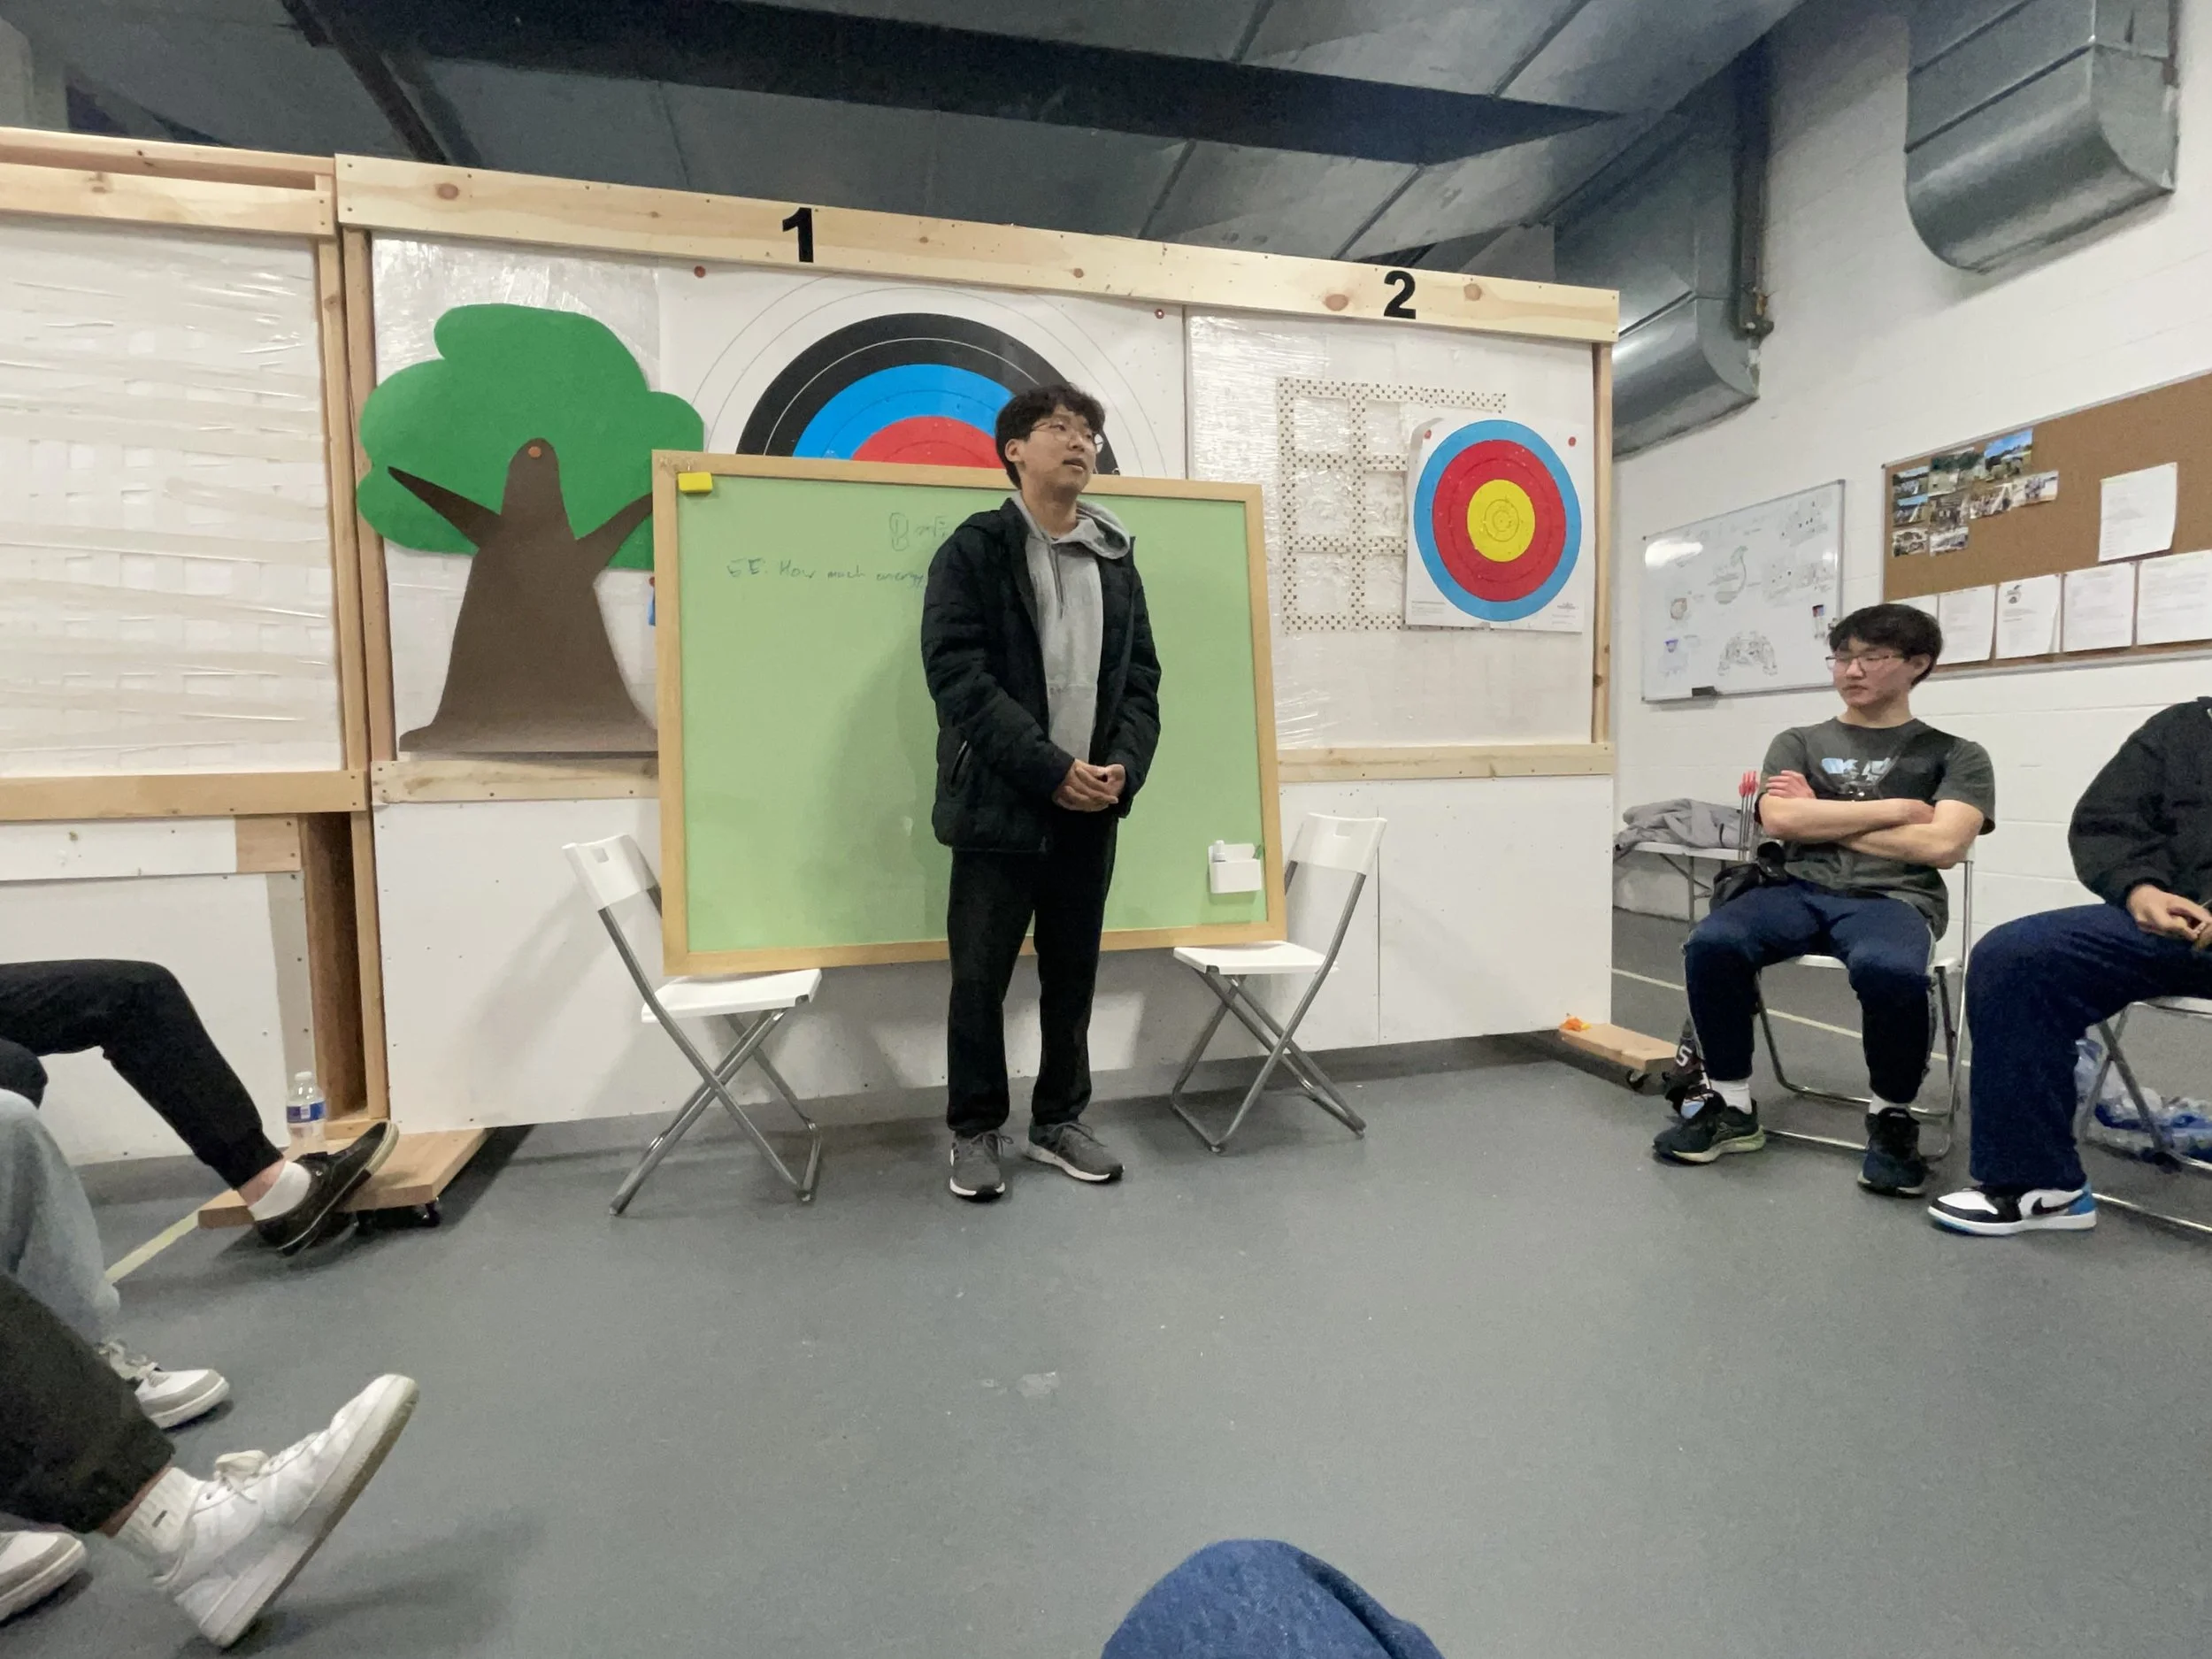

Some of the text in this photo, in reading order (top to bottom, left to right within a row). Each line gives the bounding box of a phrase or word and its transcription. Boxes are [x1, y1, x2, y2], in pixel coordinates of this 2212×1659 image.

[782, 206, 814, 264] 1
[1383, 270, 1417, 320] 2
[779, 558, 817, 579] How
